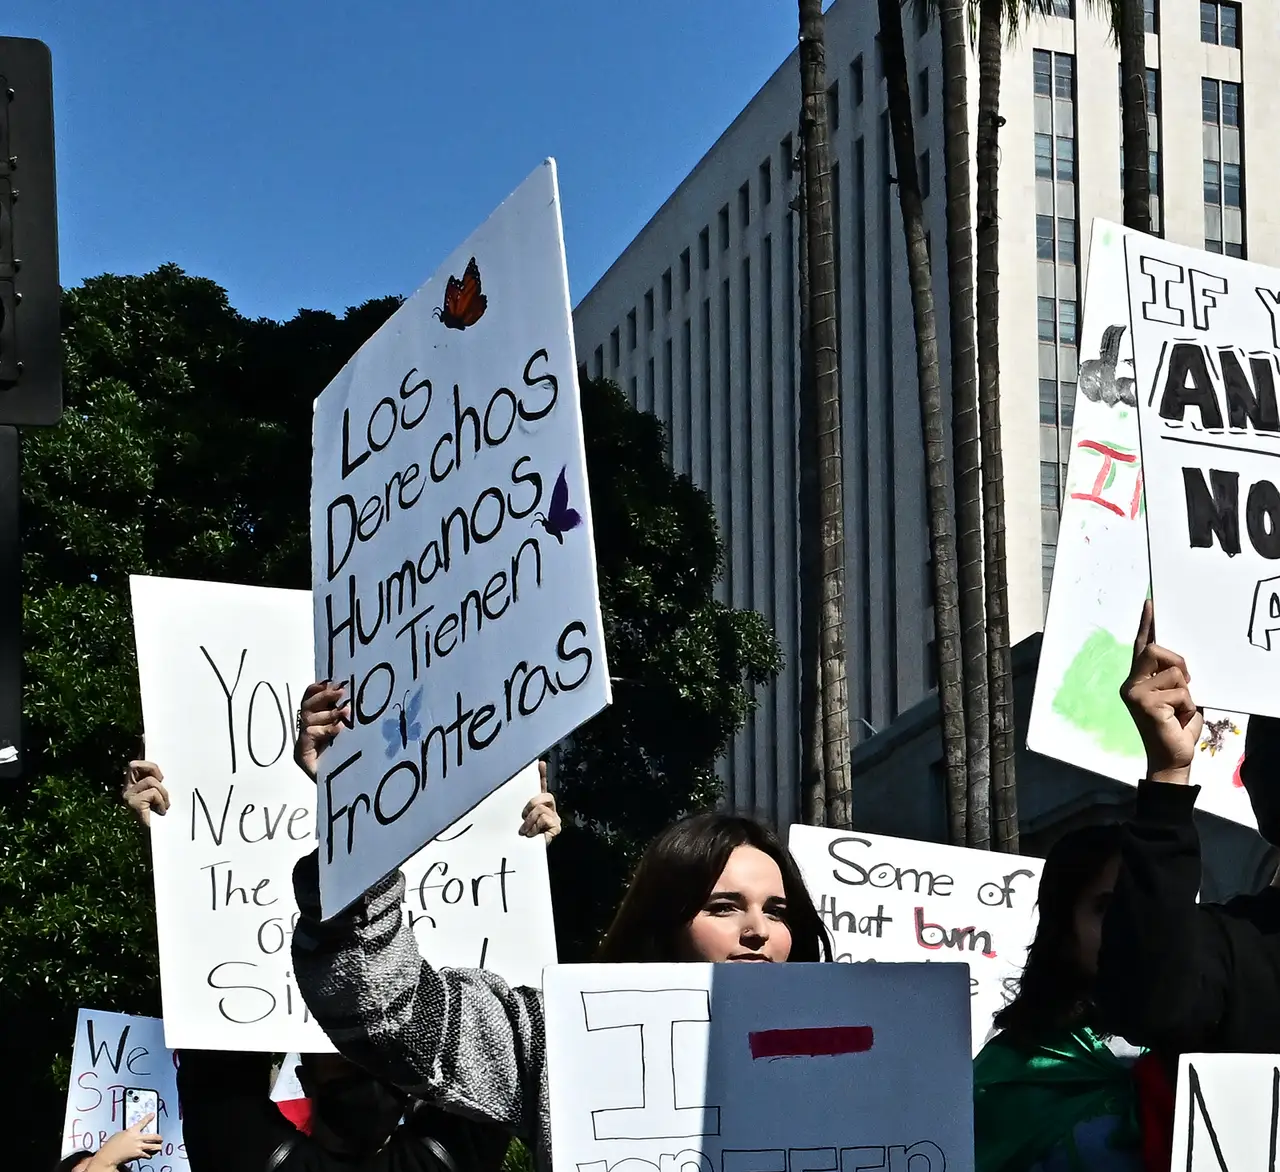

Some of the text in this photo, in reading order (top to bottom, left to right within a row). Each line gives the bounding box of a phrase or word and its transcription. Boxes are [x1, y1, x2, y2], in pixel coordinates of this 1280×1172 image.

[1139, 255, 1228, 330] IF
[327, 348, 559, 581] Derechos
[342, 367, 432, 478] Los
[326, 455, 544, 680] Humanos
[396, 537, 541, 680] Tienen
[325, 620, 594, 863] Fronteras
[191, 784, 319, 846] Neve
[200, 857, 516, 913] The fort
[817, 894, 892, 937] that
[828, 837, 1035, 908] Some of
[87, 1019, 151, 1076] We
[581, 988, 721, 1140] I
